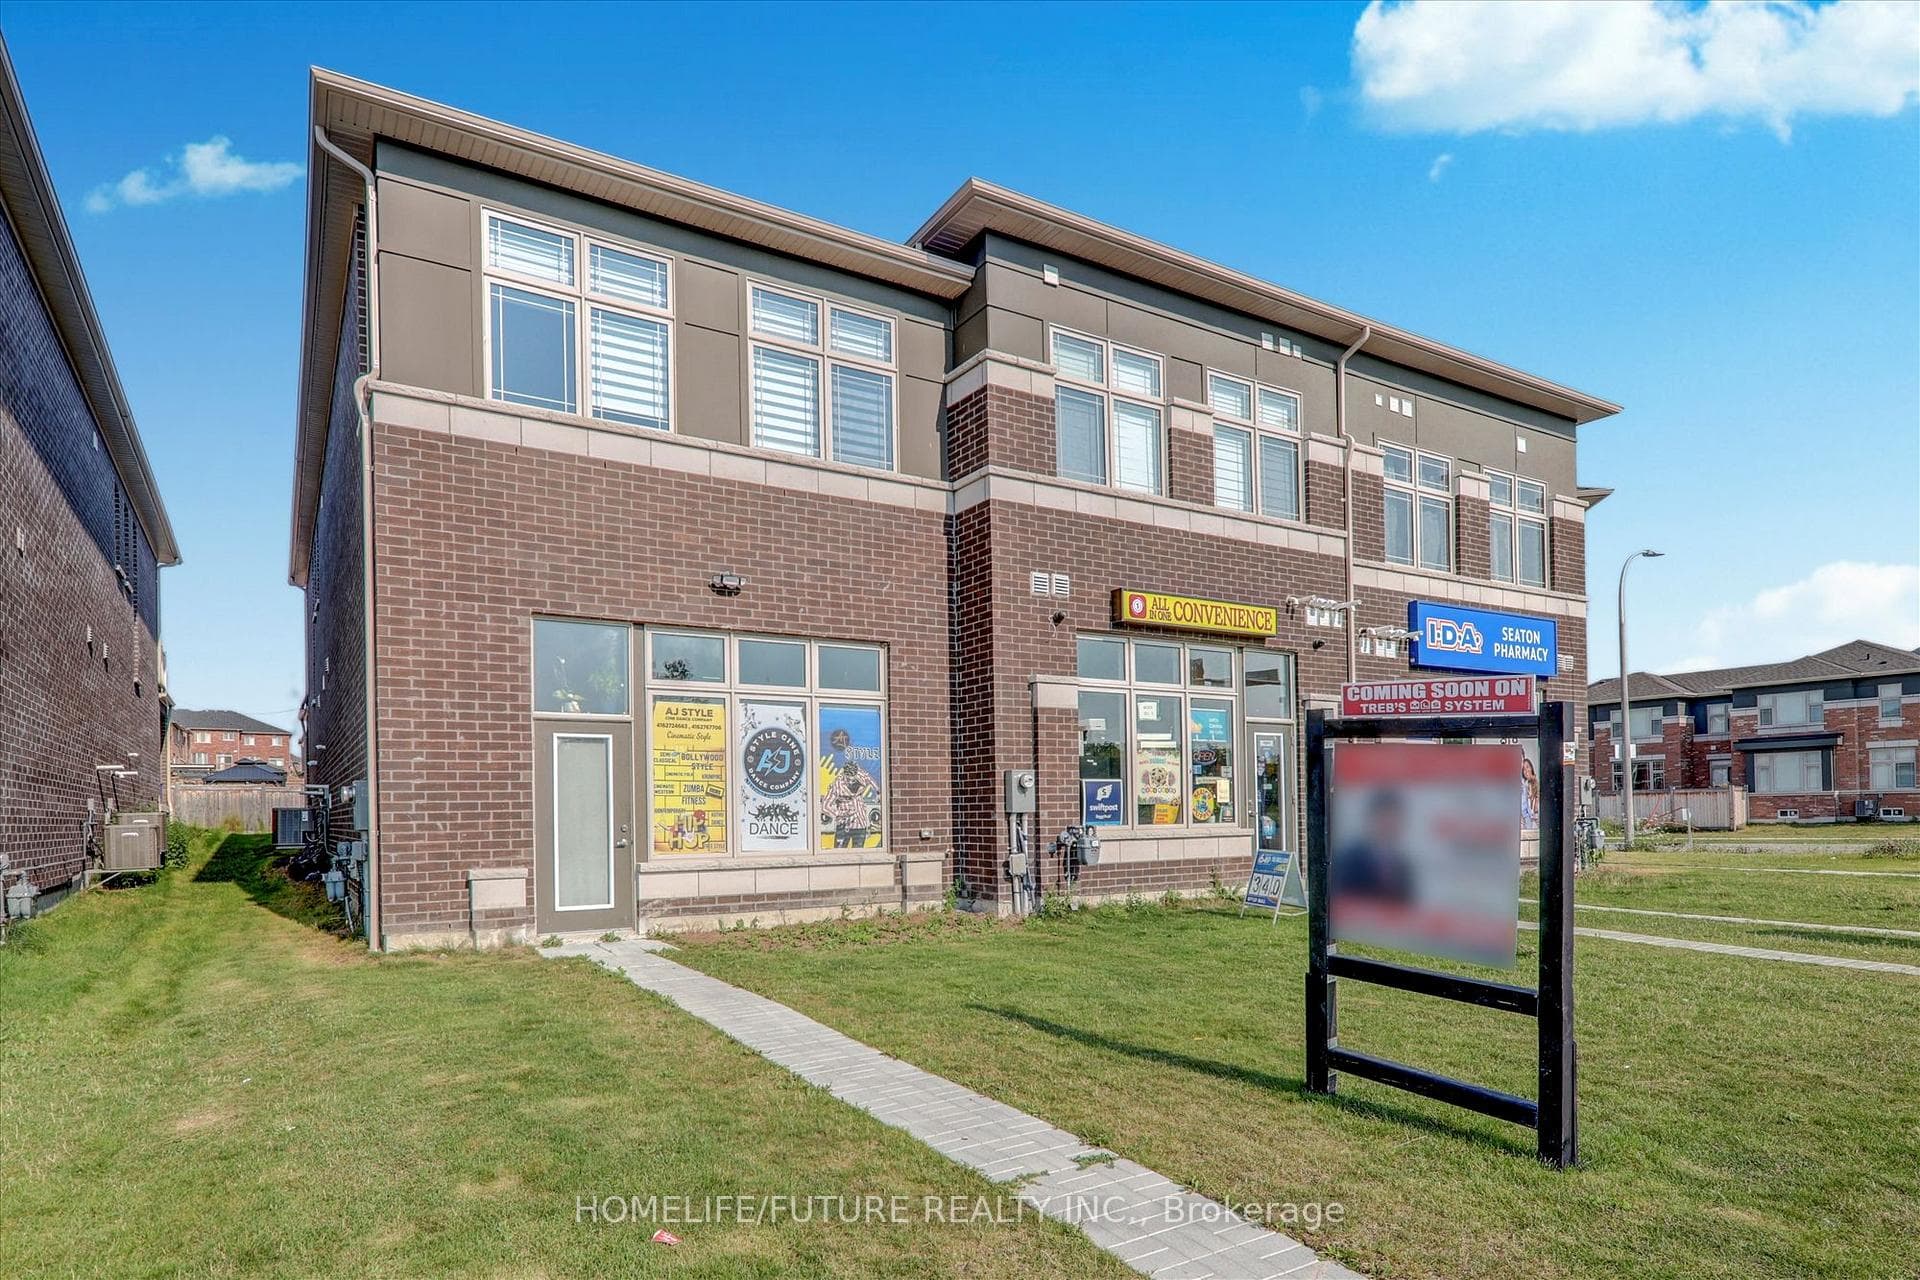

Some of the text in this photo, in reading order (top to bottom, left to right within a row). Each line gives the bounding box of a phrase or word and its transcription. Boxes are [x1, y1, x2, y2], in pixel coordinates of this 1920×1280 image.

[1152, 597, 1170, 611] ALL
[1150, 610, 1172, 621] IN ONE
[1173, 601, 1273, 631] CONVENIENCE
[1502, 627, 1541, 644] SEATON
[1494, 643, 1548, 661] PHARMACY
[1347, 684, 1427, 701] COMING
[1431, 682, 1490, 698] SOON
[1495, 679, 1526, 696] ON
[665, 707, 714, 717] AJ STYLE
[1360, 703, 1407, 714] TREB'S
[1444, 700, 1505, 711] SYSTEM
[667, 731, 711, 742] Cinematic Style
[749, 731, 800, 756] STYLE CINE
[681, 752, 724, 761] BOLLYWOOD
[756, 748, 791, 774] AJ
[691, 762, 714, 770] STYLE
[748, 767, 768, 789] DANCE
[769, 770, 800, 790] COMPANY
[683, 784, 704, 793] ZUMBA
[682, 796, 706, 805] FITNESS
[1089, 802, 1118, 814] swiftpost
[749, 822, 799, 836] DANCE
[669, 832, 710, 851] HOP
